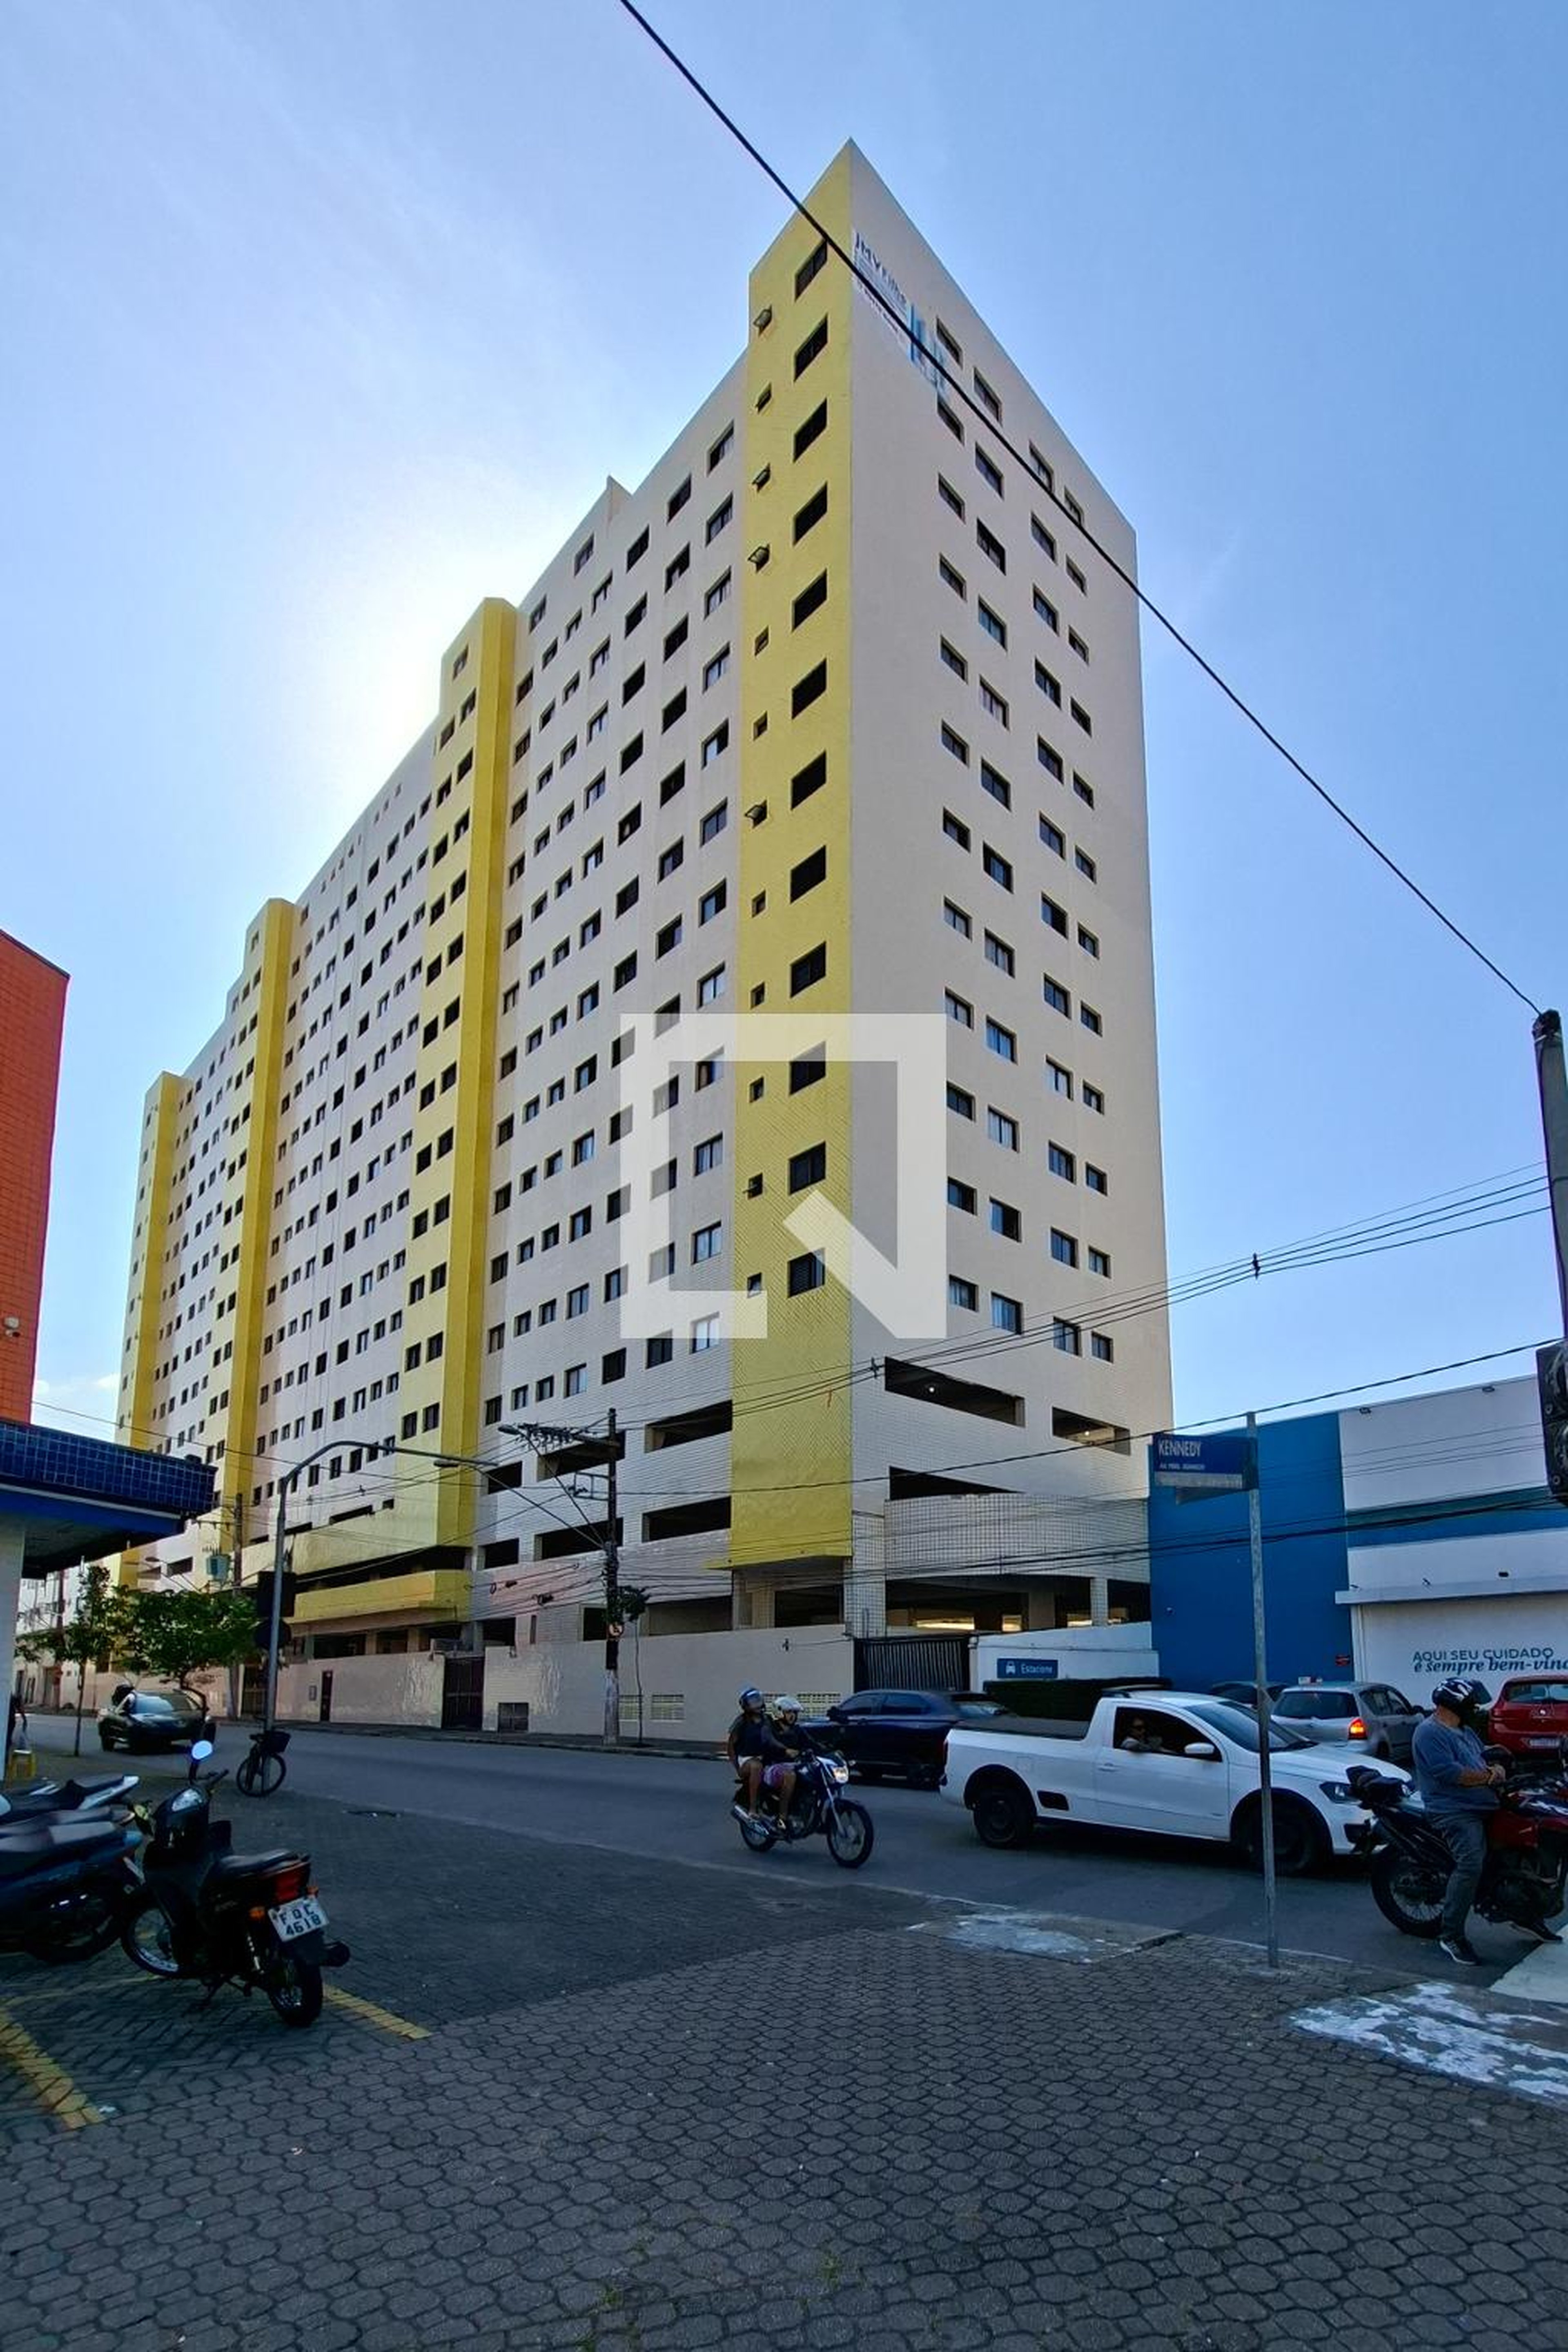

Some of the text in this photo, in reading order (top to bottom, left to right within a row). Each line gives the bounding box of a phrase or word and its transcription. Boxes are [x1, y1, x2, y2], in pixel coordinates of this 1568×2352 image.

[1158, 1440, 1201, 1457] KENNEDY
[1413, 1647, 1554, 1661] AQUI SEU CUIDADO
[1425, 1661, 1485, 1675] sempre
[286, 1913, 321, 1935] 4618
